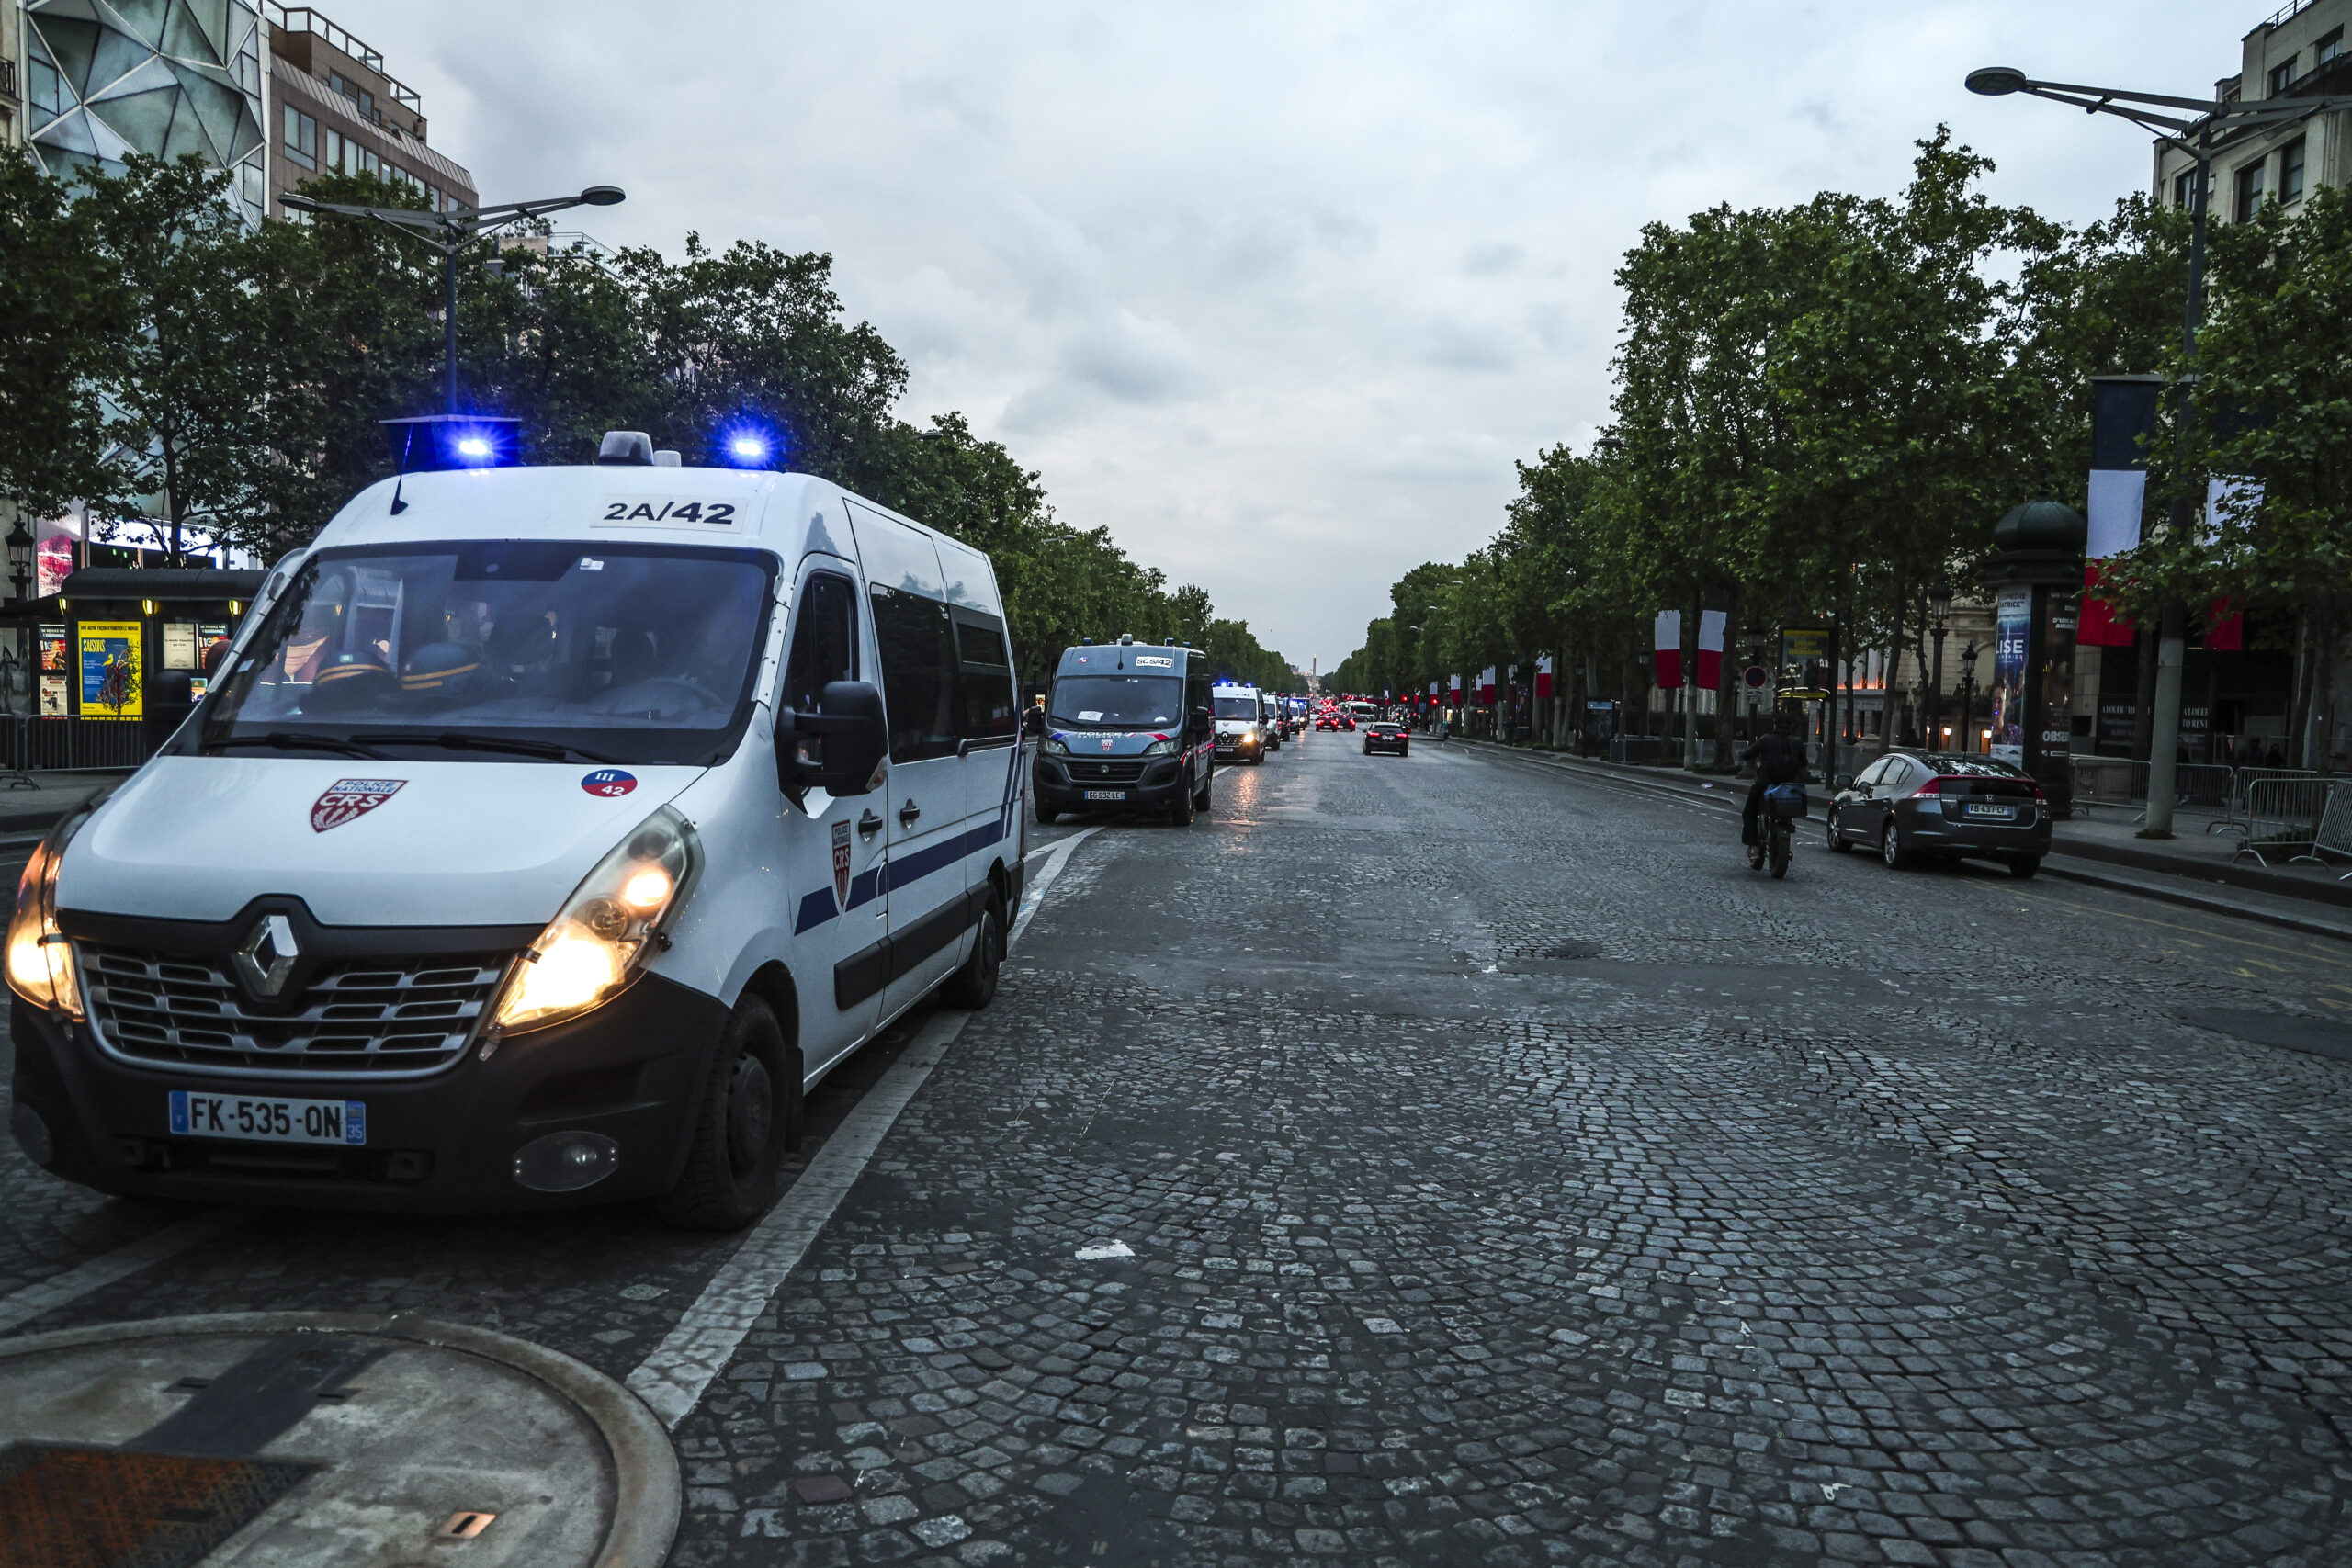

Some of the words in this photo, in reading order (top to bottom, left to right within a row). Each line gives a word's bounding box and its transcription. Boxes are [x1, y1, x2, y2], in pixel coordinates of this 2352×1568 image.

[603, 501, 736, 525] 2A/42
[83, 638, 106, 653] SAISONS
[1136, 658, 1171, 667] SCS/42
[601, 785, 625, 795] 42
[319, 794, 384, 807] CRS
[834, 847, 850, 871] CRS
[190, 1097, 342, 1139] FK-535-QN
[347, 1123, 363, 1139] 35
